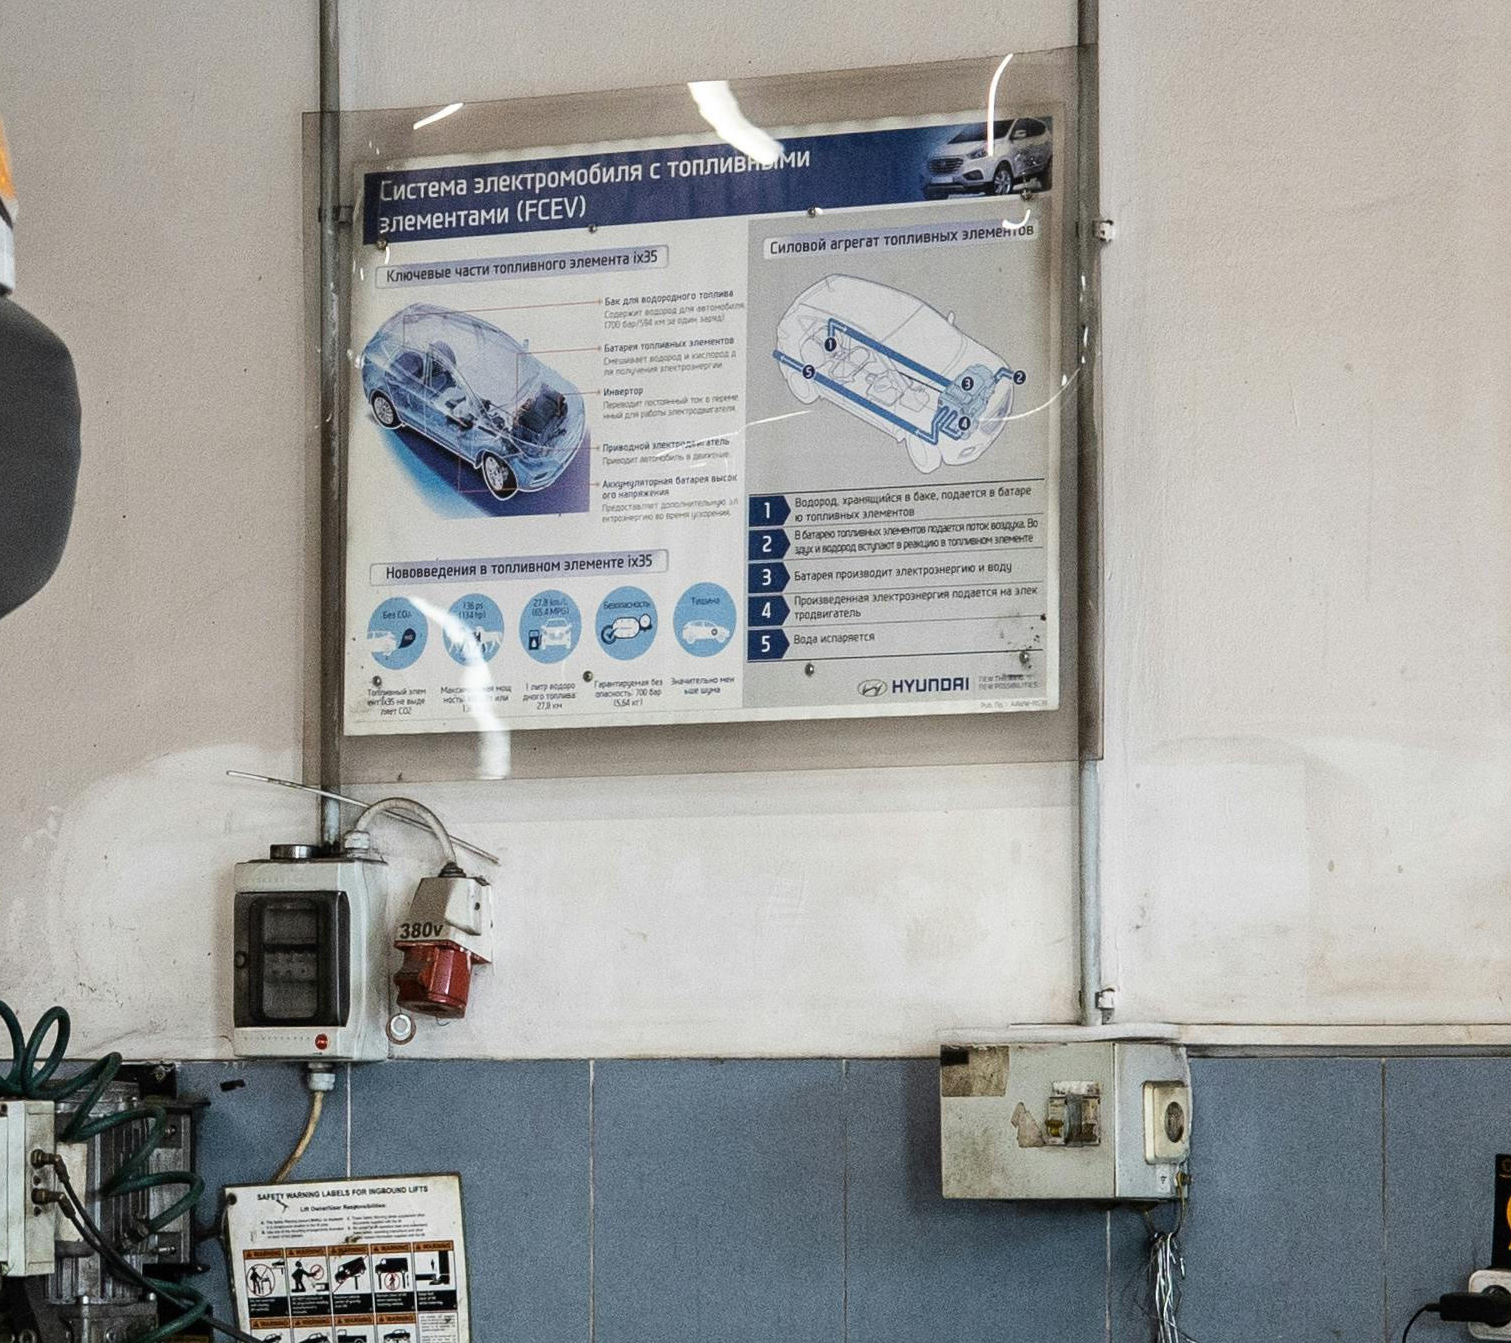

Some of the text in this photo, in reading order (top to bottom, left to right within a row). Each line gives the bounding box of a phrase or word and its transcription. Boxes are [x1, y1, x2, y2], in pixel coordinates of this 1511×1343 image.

[380, 176, 467, 202] Система
[473, 164, 642, 194] электромобиля
[650, 162, 660, 180] с
[379, 195, 586, 233] элементами (FCEV)
[770, 225, 1034, 254] Силовой агрегат топливных элементов
[386, 250, 658, 282] Ключевые части топливного элемента ix35
[604, 290, 734, 306] Бак для водородного топлива
[604, 310, 642, 319] Содержит
[645, 307, 677, 317] водород
[679, 305, 694, 315] для
[604, 337, 735, 353] Батарея топливных элементов
[603, 351, 729, 366] Смешивает водород кислород
[615, 362, 723, 376] получения электроэнергии
[603, 387, 644, 397] Инвертор
[603, 394, 739, 410] Переводит постоянный ток переме
[624, 411, 639, 421] для
[640, 409, 666, 419] работы
[603, 442, 650, 453] Приводной
[602, 456, 639, 466] Приводит
[602, 474, 738, 490] Аккумуляторная батарея высок
[602, 489, 669, 500] ого напряжения
[795, 487, 1032, 508] Водород, хранящийся в баке, подается в батаре
[666, 511, 690, 522] время
[764, 502, 771, 518] 1
[806, 511, 859, 522] топливных
[862, 508, 915, 519] элементов
[802, 529, 835, 540] батарею
[837, 528, 881, 538] топливных
[883, 524, 926, 535] элементов
[927, 523, 964, 534] подается
[965, 522, 990, 531] поток
[1027, 518, 1038, 528] Во
[761, 536, 772, 552] 2
[821, 544, 857, 554] водород
[858, 542, 894, 553] вступают
[903, 540, 938, 550] реакцию
[948, 537, 993, 546] топливном
[994, 535, 1034, 544] элементе
[386, 554, 653, 579] Нововведения в топливном элементе ix35
[794, 563, 1012, 581] Батарея производит электроэнергию воду
[762, 570, 771, 586] 3
[603, 600, 651, 610] Безопасность
[794, 587, 1038, 607] Произведенная электроэнергия подается на элек
[761, 602, 771, 619] 4
[794, 610, 861, 622] тродвигатель
[761, 636, 771, 652] 5
[793, 632, 875, 645] Вода испаряется
[892, 677, 969, 693] HYUNDAI
[286, 1191, 320, 1199] WARNING
[322, 1190, 350, 1198] LABELS
